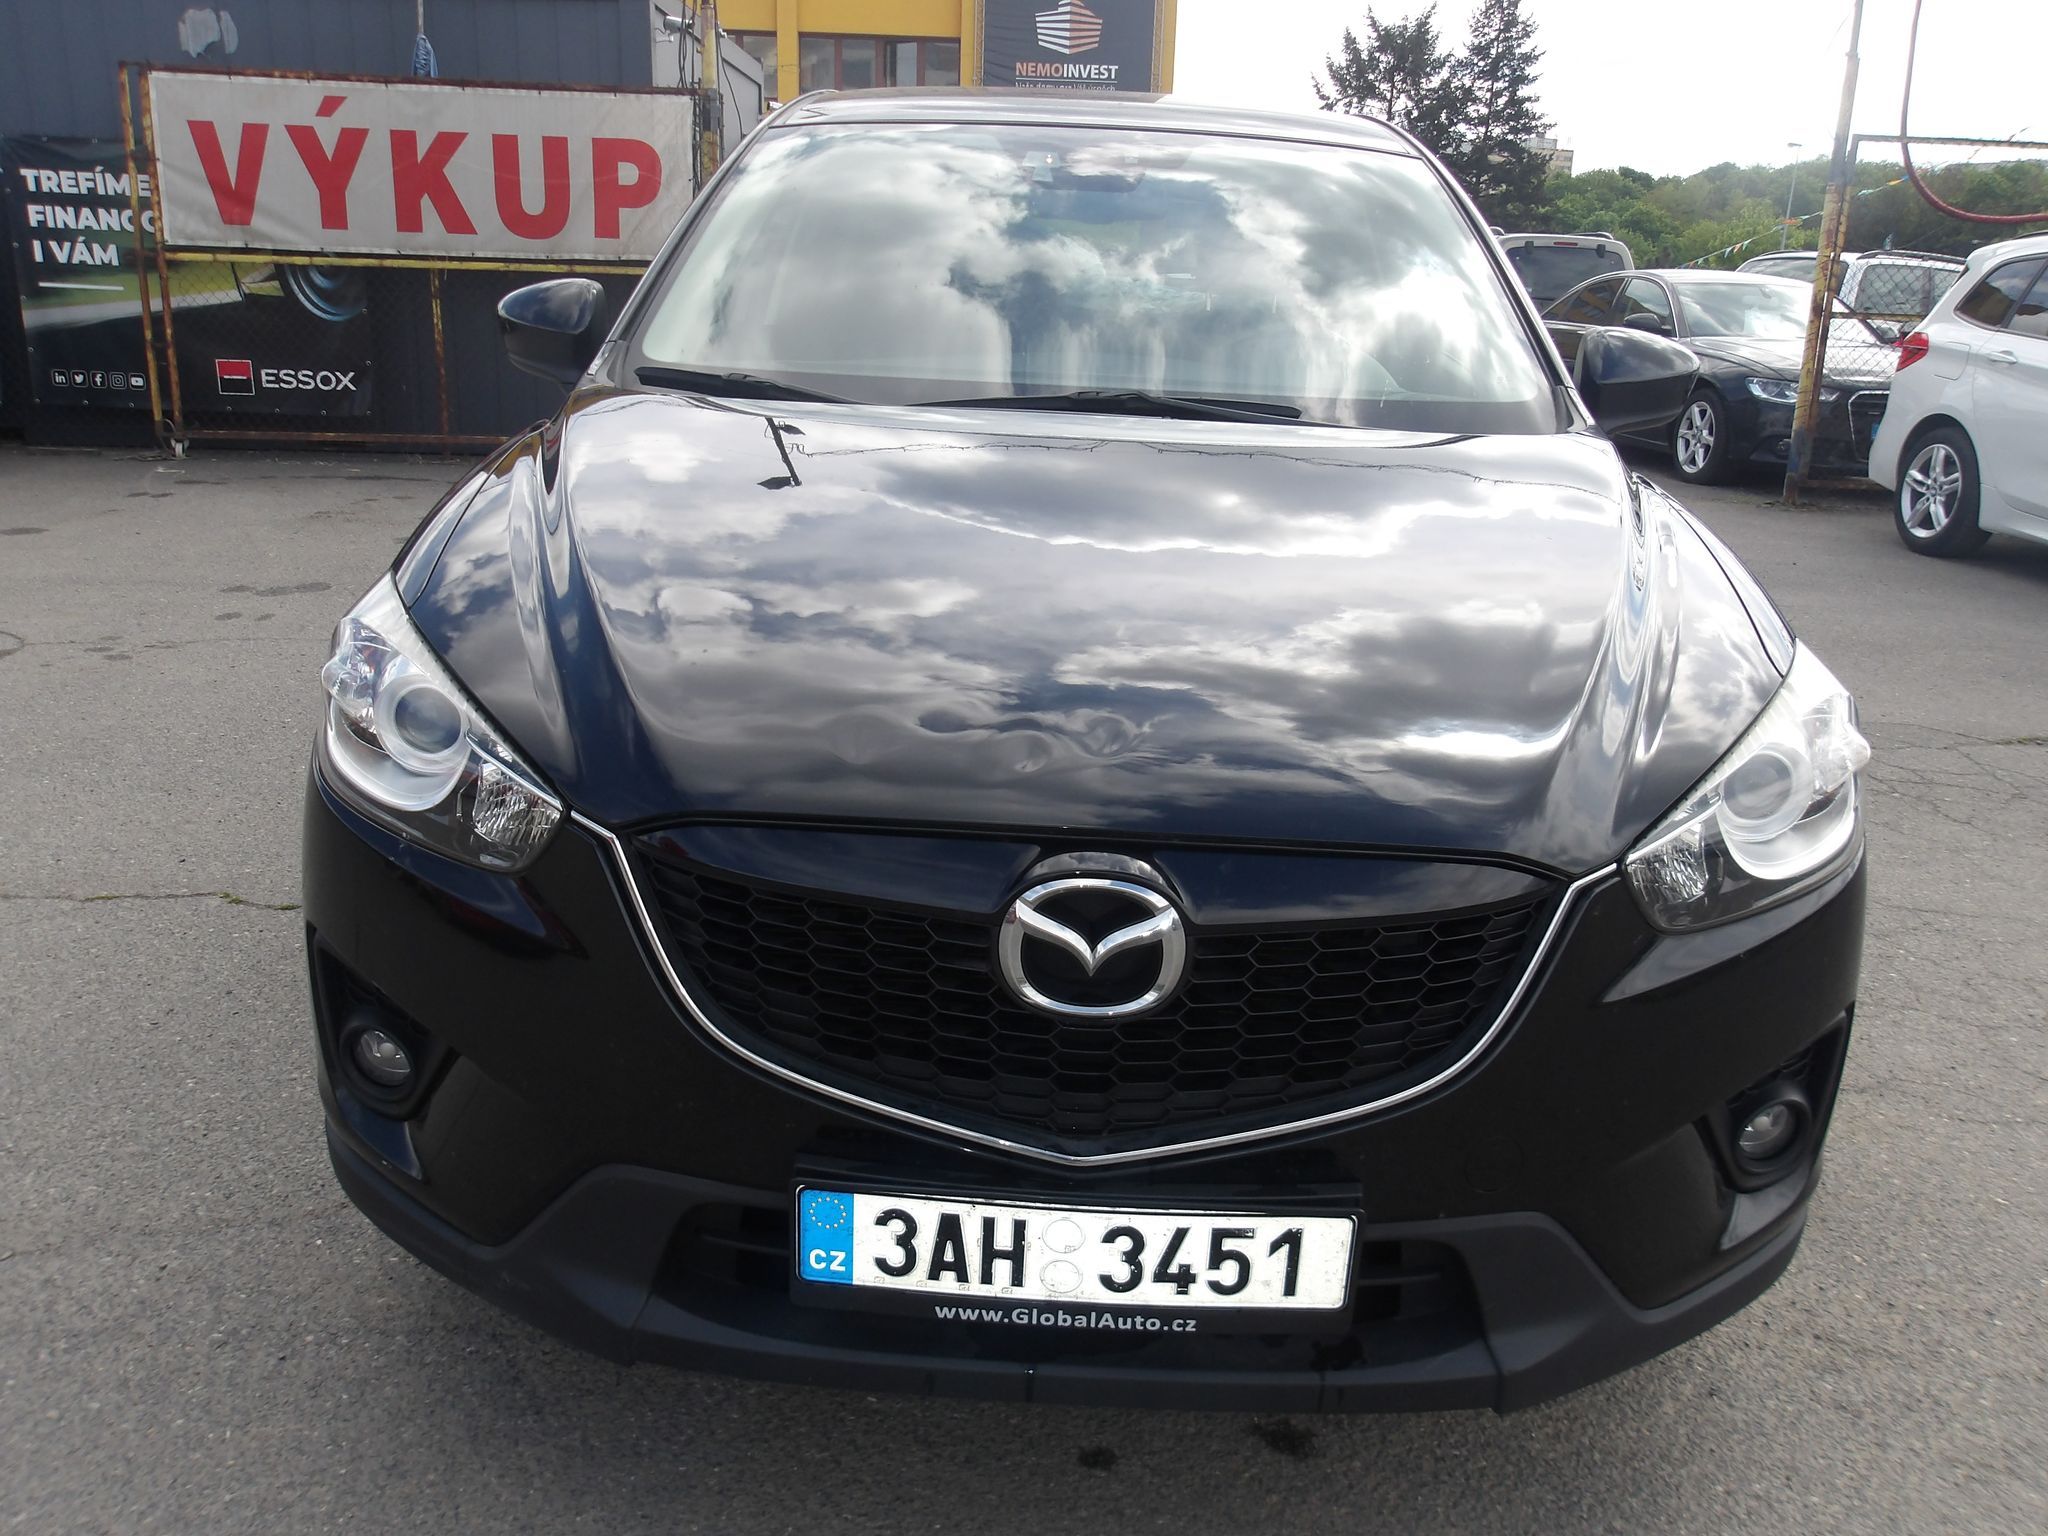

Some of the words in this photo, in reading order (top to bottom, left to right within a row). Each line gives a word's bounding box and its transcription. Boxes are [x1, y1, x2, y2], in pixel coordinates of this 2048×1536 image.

[1015, 62, 1119, 80] NEMOINVEST
[19, 165, 152, 198] TREFÍME
[186, 95, 663, 240] VÝKUP
[32, 239, 44, 263] I
[48, 235, 120, 267] VÁM
[260, 368, 357, 392] ESSOX
[808, 1248, 846, 1272] CZ
[873, 1207, 1028, 1288] 3AH
[1098, 1225, 1305, 1297] 3451
[934, 1304, 1198, 1332] www.GlobalAuto.cz
